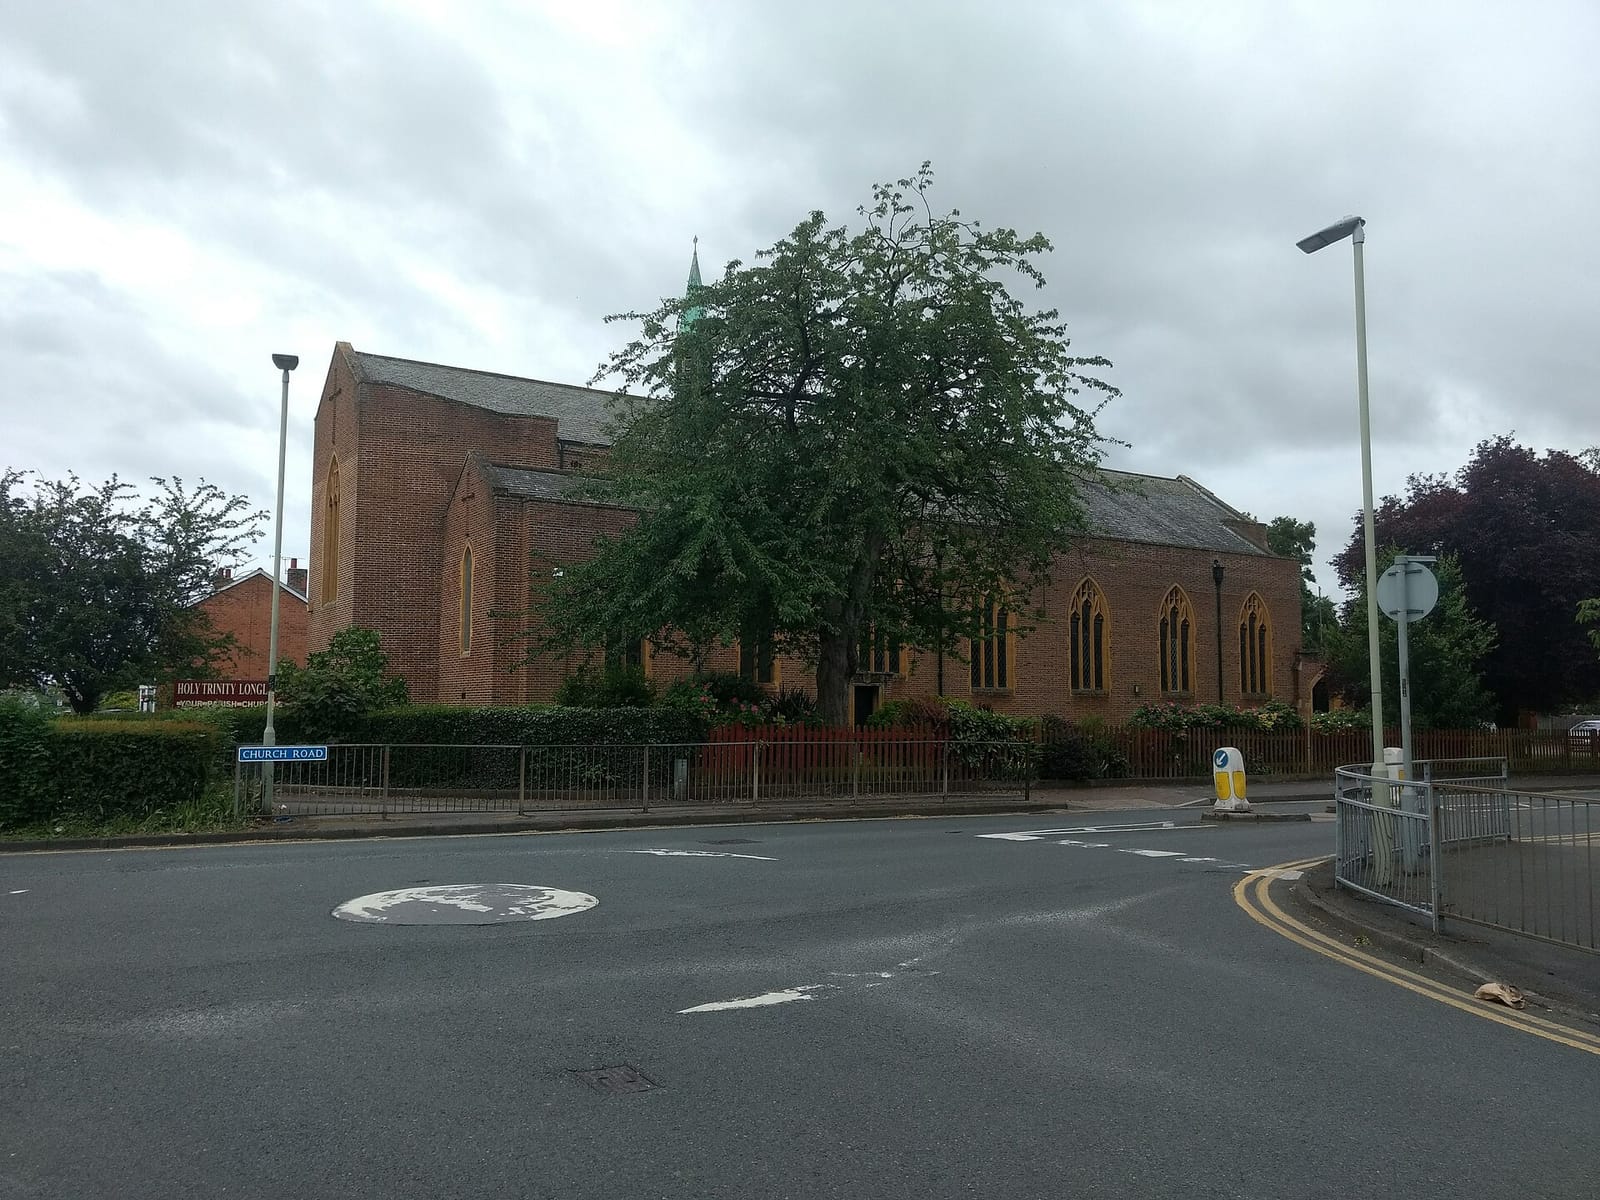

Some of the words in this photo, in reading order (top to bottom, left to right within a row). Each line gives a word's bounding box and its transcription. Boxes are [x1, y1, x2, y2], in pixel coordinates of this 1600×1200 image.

[177, 682, 201, 695] HOLY
[202, 682, 236, 695] TRINITY
[239, 682, 268, 695] LONGL
[180, 700, 203, 708] YOUR
[207, 700, 237, 708] PAISH
[242, 749, 287, 759] CHURCH
[293, 749, 323, 758] ROAD
